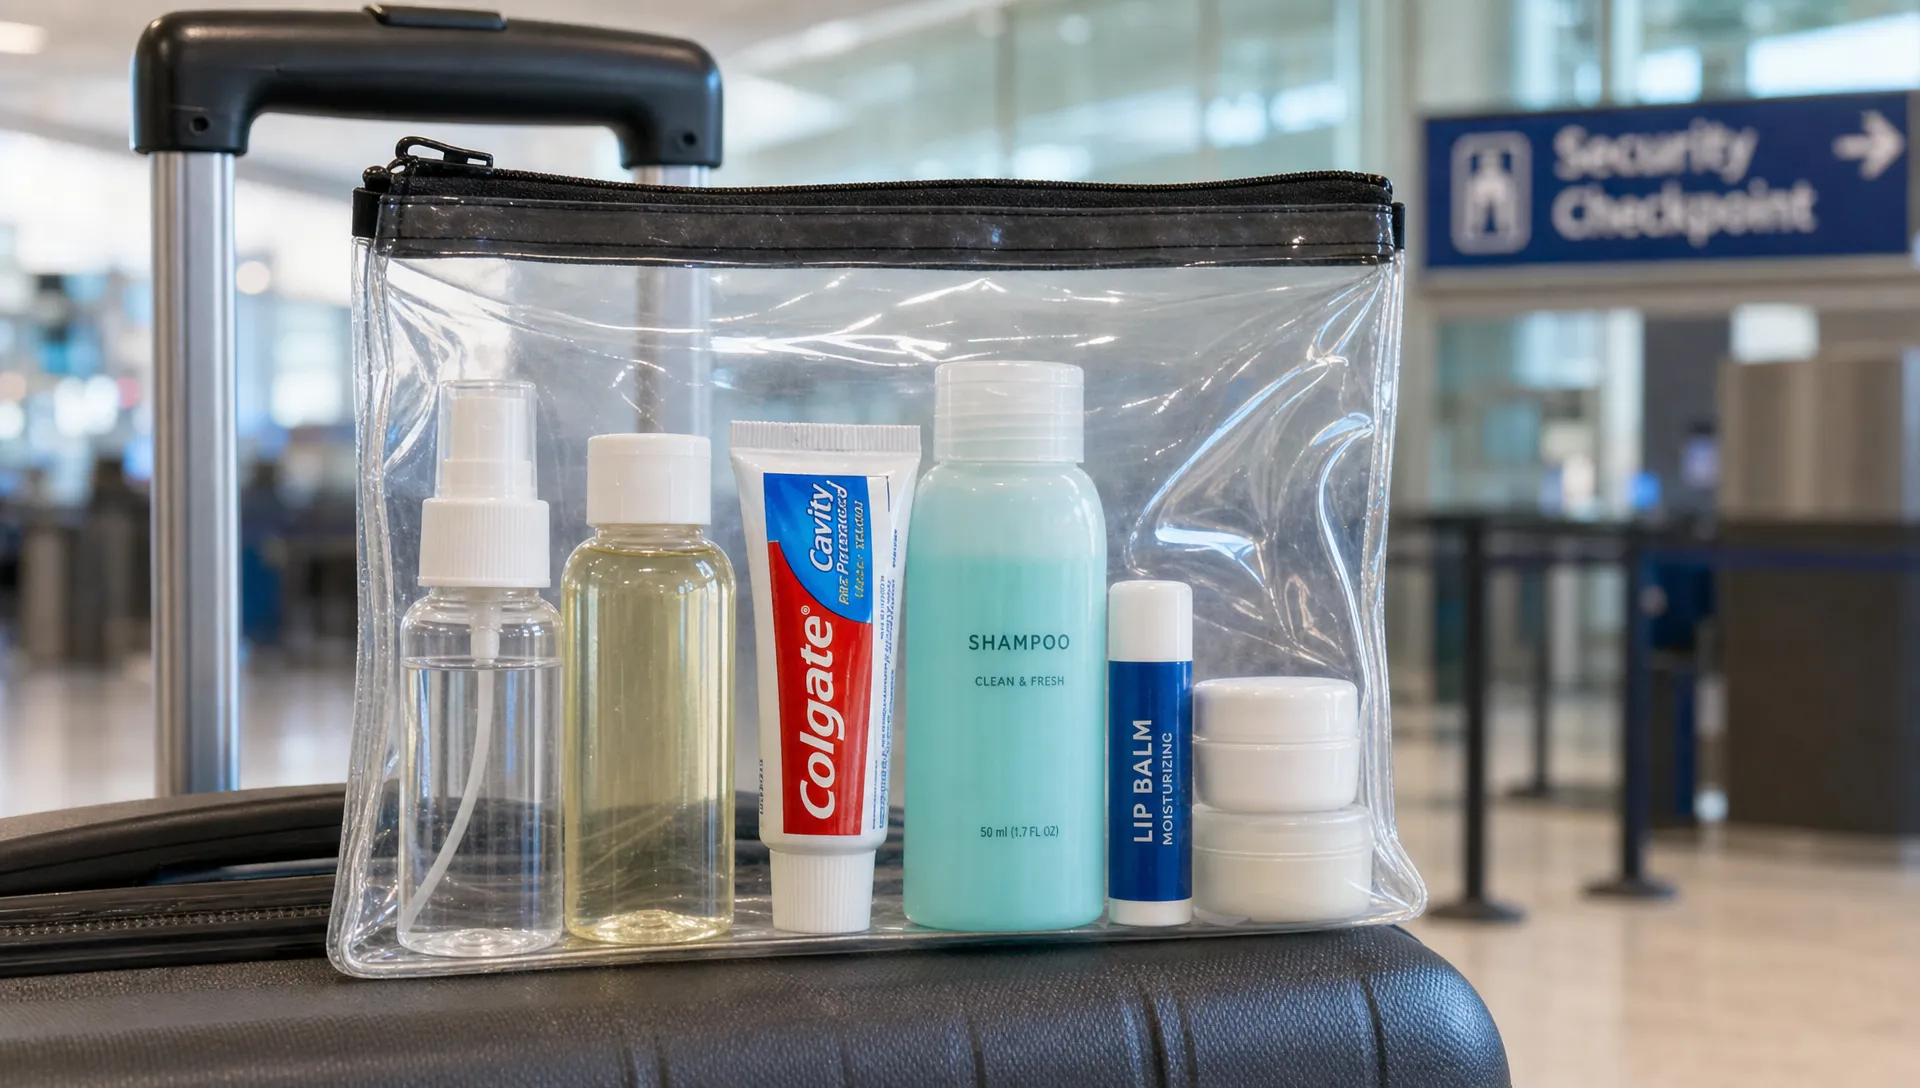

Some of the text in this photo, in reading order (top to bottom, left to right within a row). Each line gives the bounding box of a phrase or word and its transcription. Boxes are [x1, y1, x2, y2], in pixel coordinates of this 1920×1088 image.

[1553, 117, 1759, 185] Security
[1551, 177, 1818, 248] Checkpoint
[807, 482, 835, 573] Cavity
[968, 634, 1070, 650] SHAMPOO
[975, 676, 1065, 687] CLEAN & FRESH
[1132, 719, 1153, 842] LIP BALM
[980, 825, 1059, 839] 50 ml (1.7 FL OZ)
